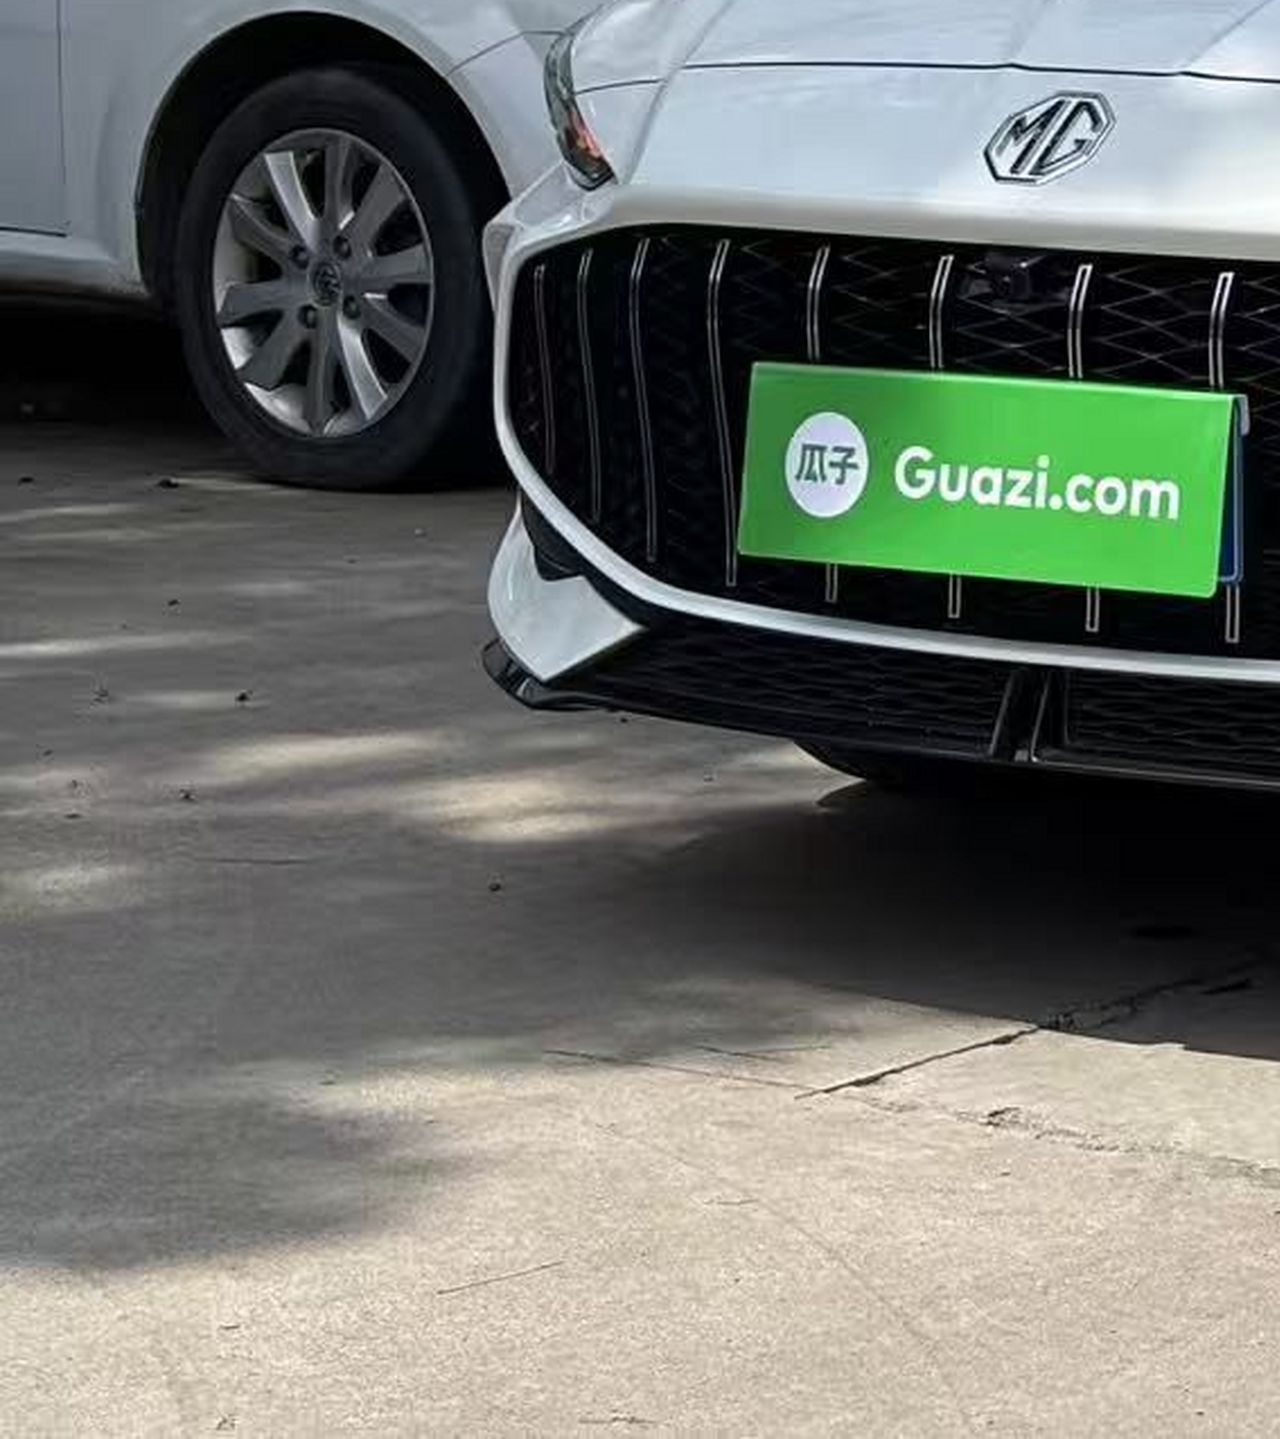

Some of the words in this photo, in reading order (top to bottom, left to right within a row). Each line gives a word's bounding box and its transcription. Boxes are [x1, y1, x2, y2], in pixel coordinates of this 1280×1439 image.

[992, 95, 1107, 177] MG
[794, 442, 860, 485] 瓜子
[894, 445, 1180, 520] Guazi.com
